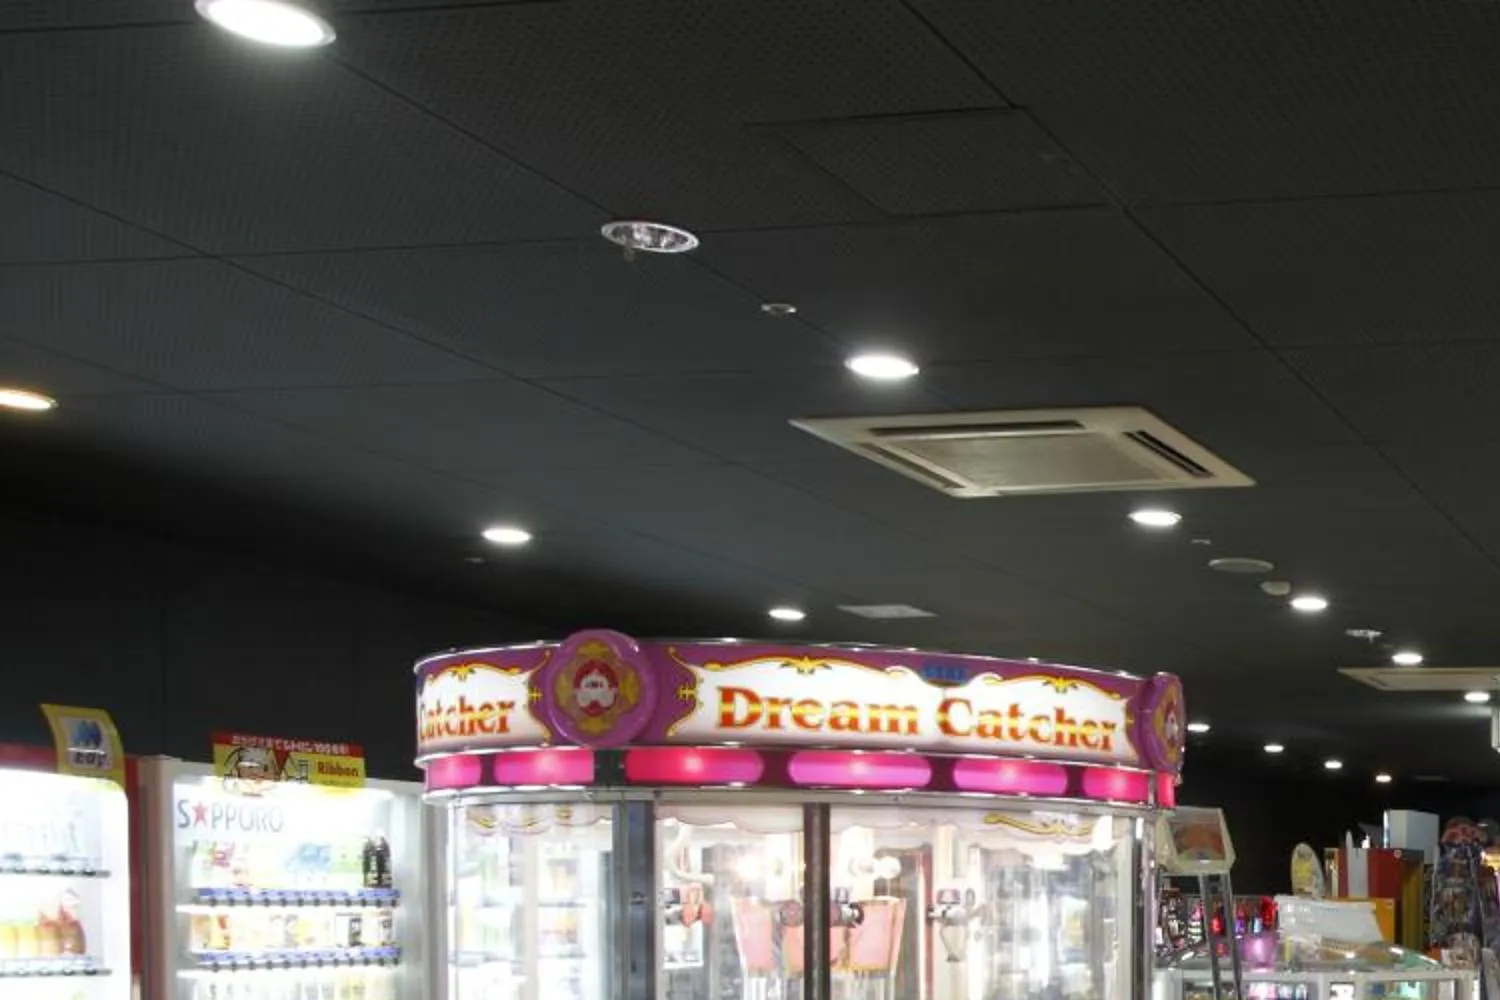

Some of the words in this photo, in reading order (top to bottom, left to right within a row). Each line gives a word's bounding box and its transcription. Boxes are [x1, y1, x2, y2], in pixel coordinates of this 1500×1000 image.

[716, 685, 920, 735] Dream
[937, 697, 1117, 750] Catcher
[317, 761, 359, 777] Ribbon
